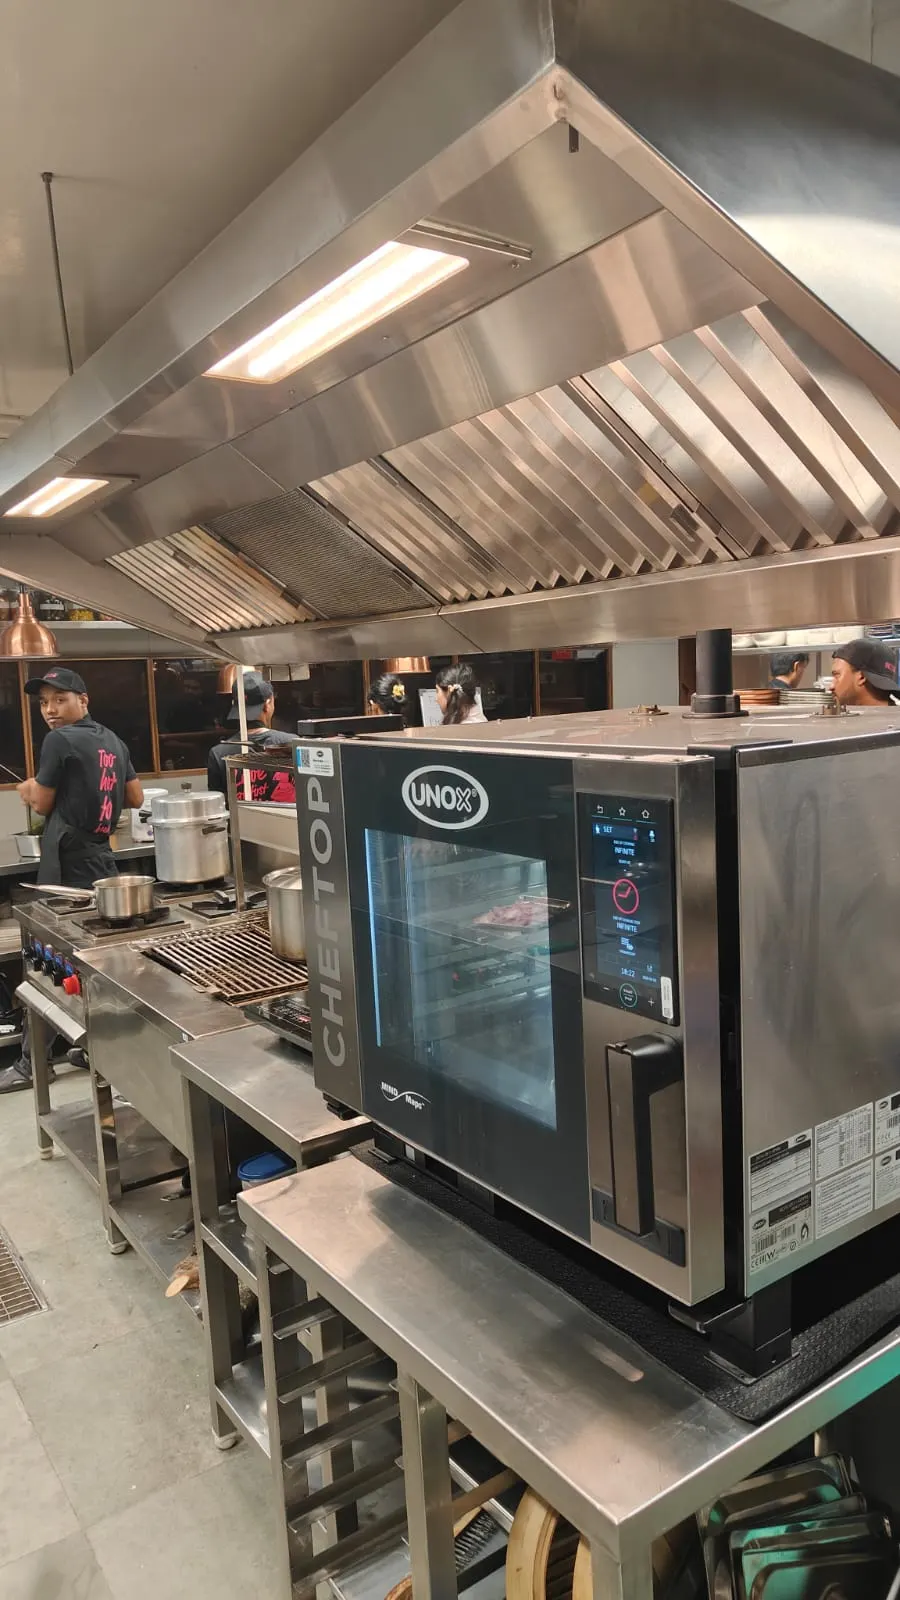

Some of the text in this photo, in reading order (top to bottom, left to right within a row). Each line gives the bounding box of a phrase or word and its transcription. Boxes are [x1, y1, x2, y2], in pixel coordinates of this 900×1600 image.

[98, 748, 116, 768] Too
[233, 769, 267, 787] Lve
[100, 796, 113, 821] to
[603, 825, 613, 834] SET
[614, 847, 635, 857] INFINITE
[306, 776, 347, 1068] CHEFTOP
[616, 922, 638, 933] INFINITE
[381, 1081, 399, 1097] MIND
